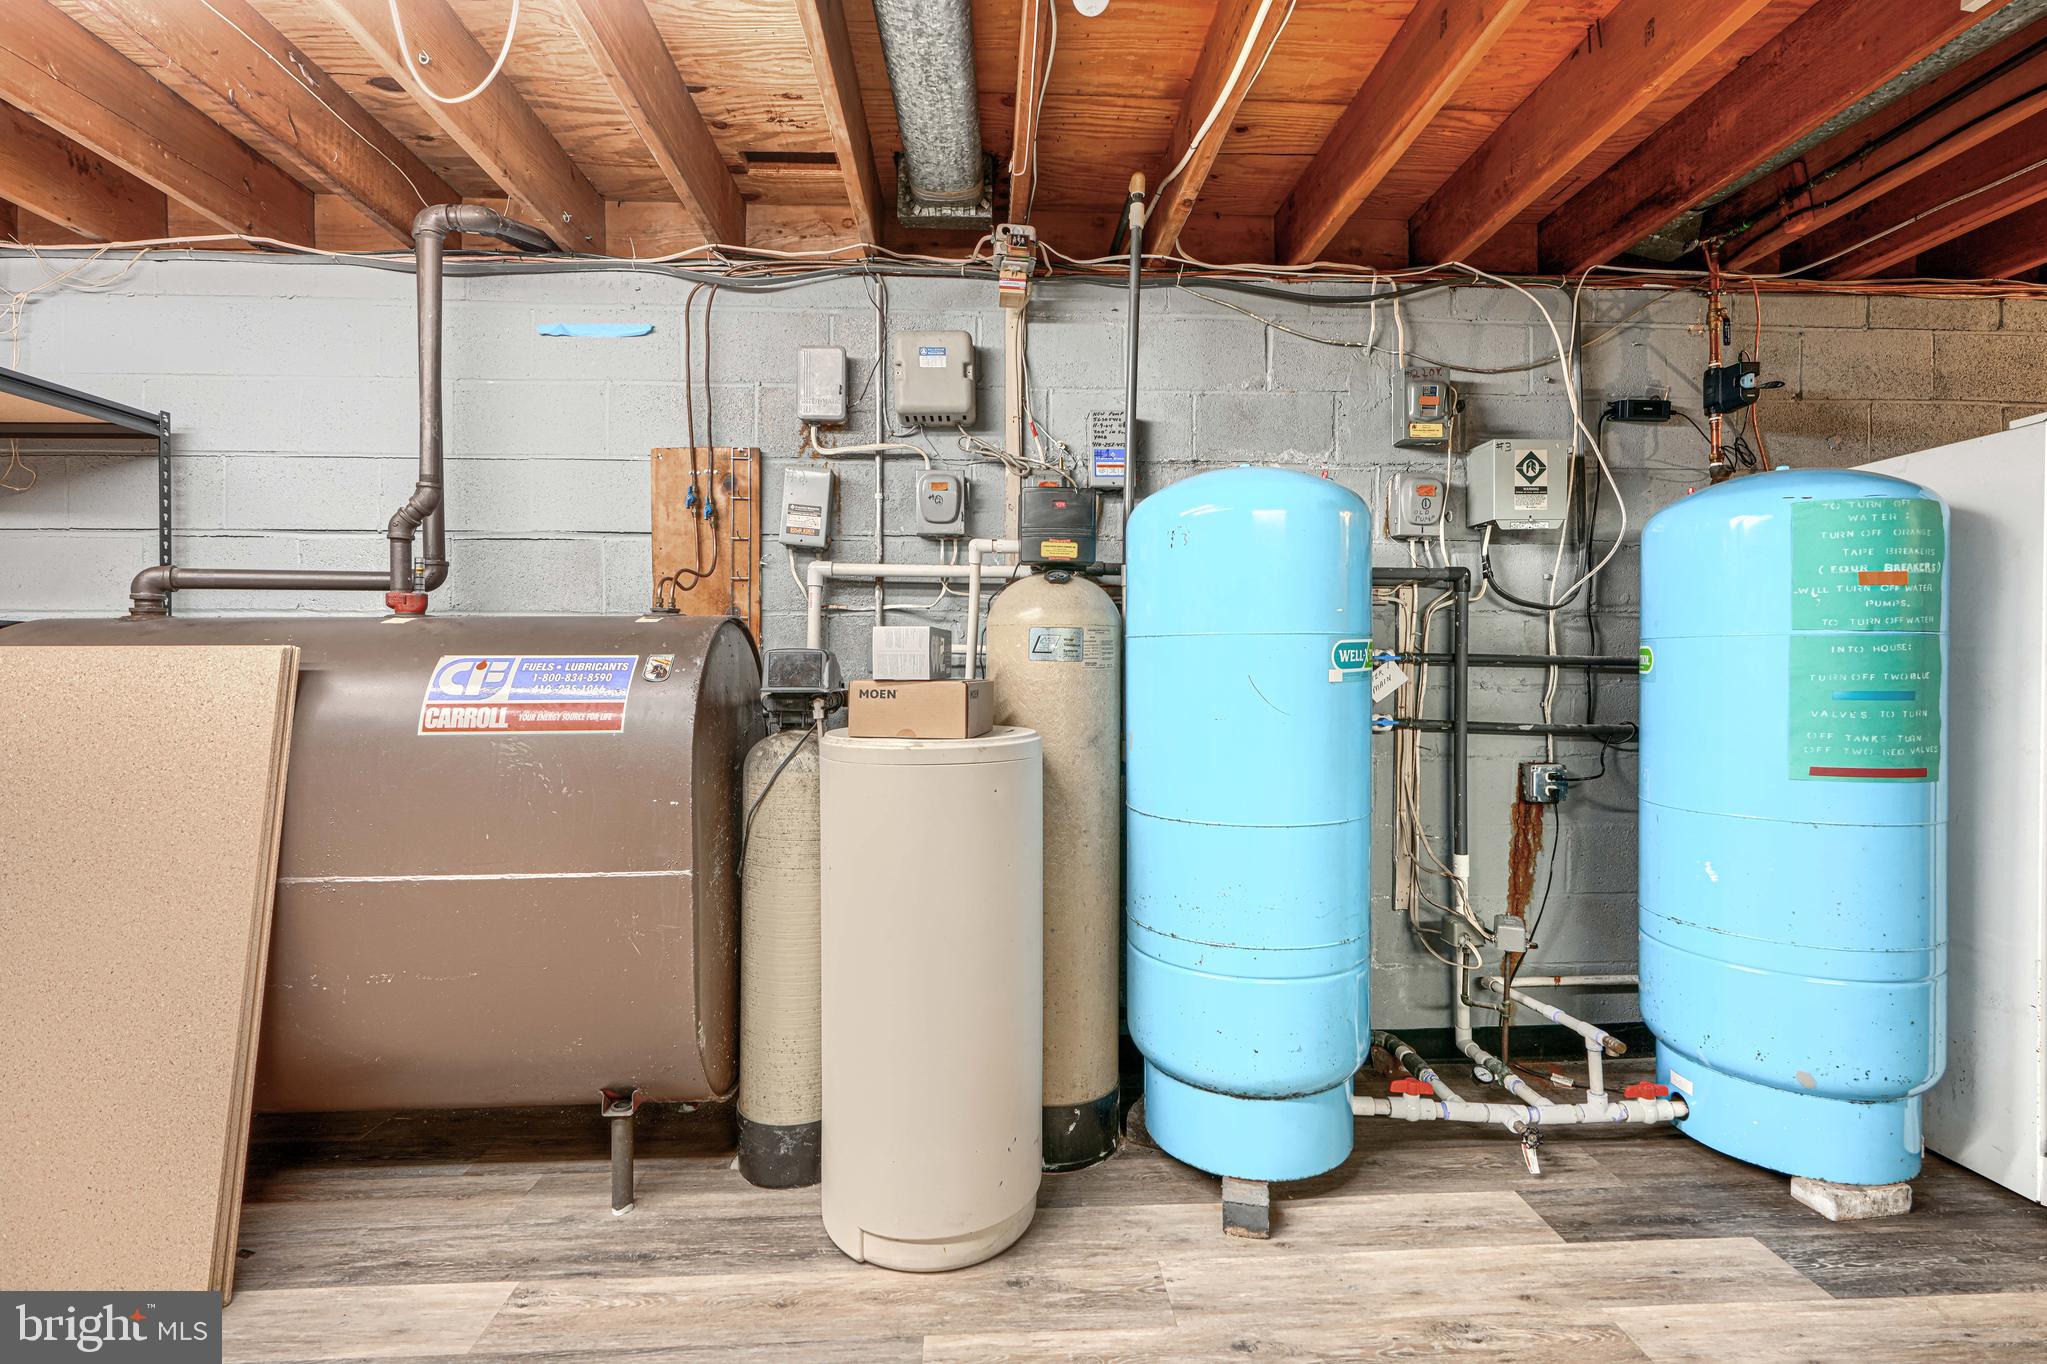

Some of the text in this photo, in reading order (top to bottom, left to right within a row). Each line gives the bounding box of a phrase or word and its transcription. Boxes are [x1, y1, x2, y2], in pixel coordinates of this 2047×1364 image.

[1495, 442, 1511, 452] #3
[1847, 501, 1882, 509] TURN
[1893, 499, 1911, 508] OFF
[1820, 530, 1855, 540] TURN
[1860, 529, 1883, 537] OFF
[1842, 547, 1936, 556] TAPE BREAKERS
[1837, 585, 1871, 593] TURN
[1880, 585, 1901, 593] OFF
[1905, 583, 1933, 592] WATER
[1822, 618, 1839, 626] TO
[1849, 618, 1881, 626] TURN
[1905, 616, 1934, 624] WATER
[1831, 645, 1864, 653] INTO
[522, 662, 555, 671] FUELS
[565, 662, 629, 671] LUBRICANTS
[533, 673, 613, 682] 1-800-834-8590
[1809, 671, 1931, 682] TURN OFF TWO BLUE
[859, 689, 897, 699] MOEN
[425, 707, 508, 729] CARROLL
[519, 711, 536, 721] YOUR
[561, 711, 586, 721] SOURCE
[1880, 710, 1895, 718] TO
[1903, 710, 1928, 718] TURN
[1807, 732, 1922, 743] OFF TANKS TURN
[1844, 747, 1873, 756] TWO
[1882, 748, 1905, 756] RED
[1910, 745, 1938, 755] VALVES
